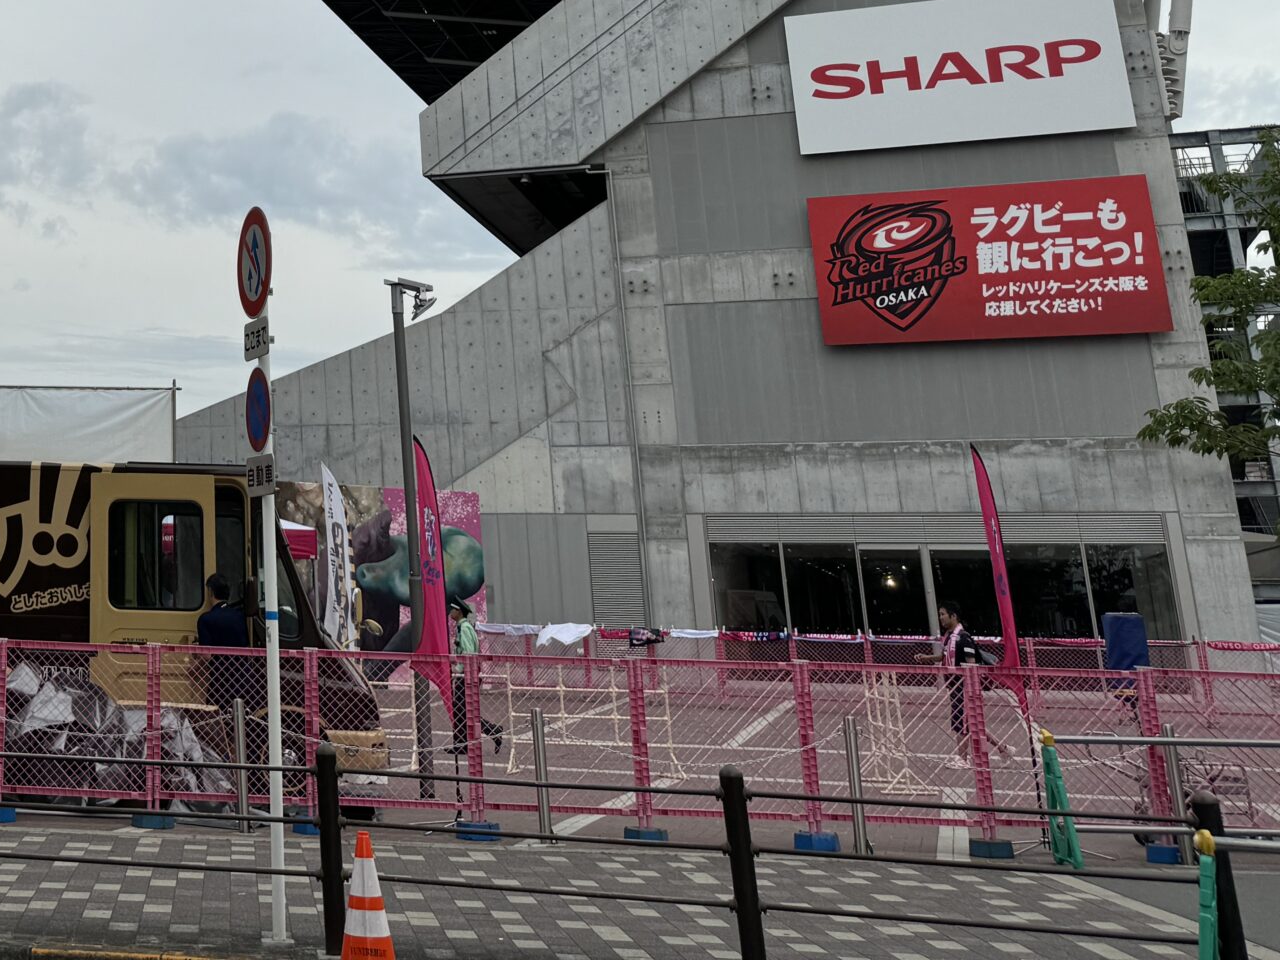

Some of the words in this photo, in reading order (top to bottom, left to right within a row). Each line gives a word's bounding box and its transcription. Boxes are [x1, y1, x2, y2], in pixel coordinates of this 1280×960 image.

[810, 38, 1102, 100] SHARP
[970, 198, 1126, 239] ラグビーも
[976, 231, 1144, 275] 観に行こっ！
[826, 253, 887, 283] Red
[835, 257, 967, 303] Hurricanes
[875, 285, 929, 309] OSAKA
[982, 275, 1148, 298] レッドハリケーンズ大阪を
[985, 296, 1103, 317] 応援してください！
[245, 325, 267, 352] ここまで
[248, 463, 273, 488] 自動車
